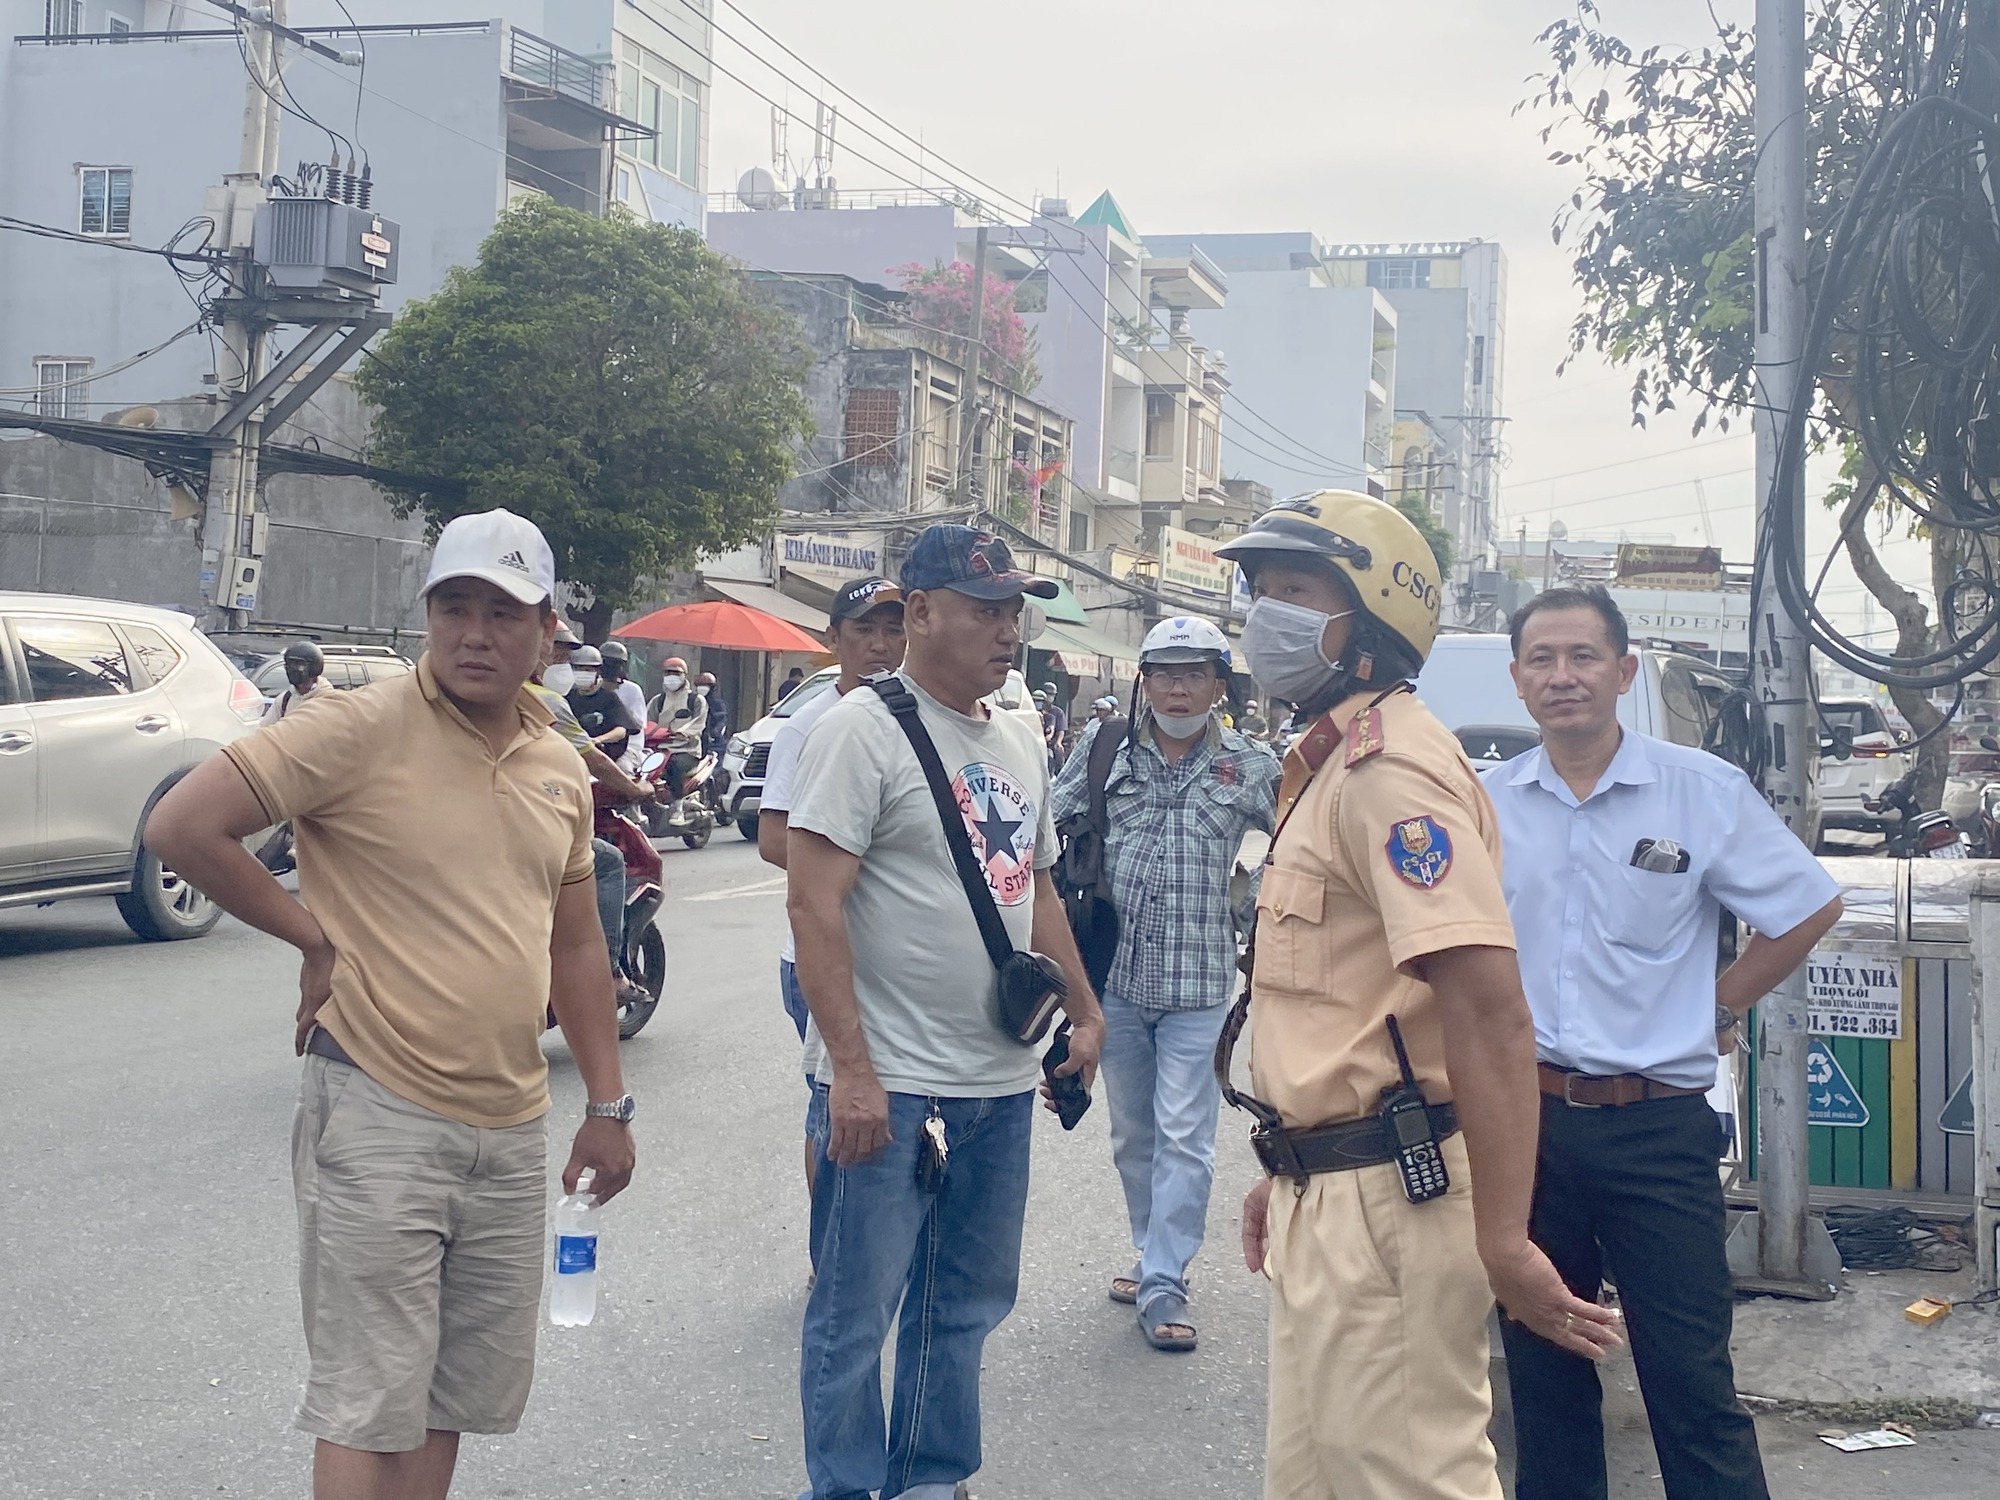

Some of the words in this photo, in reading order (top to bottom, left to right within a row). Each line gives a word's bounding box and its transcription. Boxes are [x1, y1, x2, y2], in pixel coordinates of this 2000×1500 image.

[785, 537, 831, 565] KHÁNH
[833, 545, 876, 571] KHANG
[498, 558, 530, 574] adidas
[1392, 561, 1441, 611] CSG
[958, 777, 1030, 817] CONVERSE
[1425, 850, 1443, 863] GT
[1859, 963, 1899, 988] NHÀ
[1812, 986, 1845, 1000] TRỌN
[1830, 1015, 1859, 1034] 722
